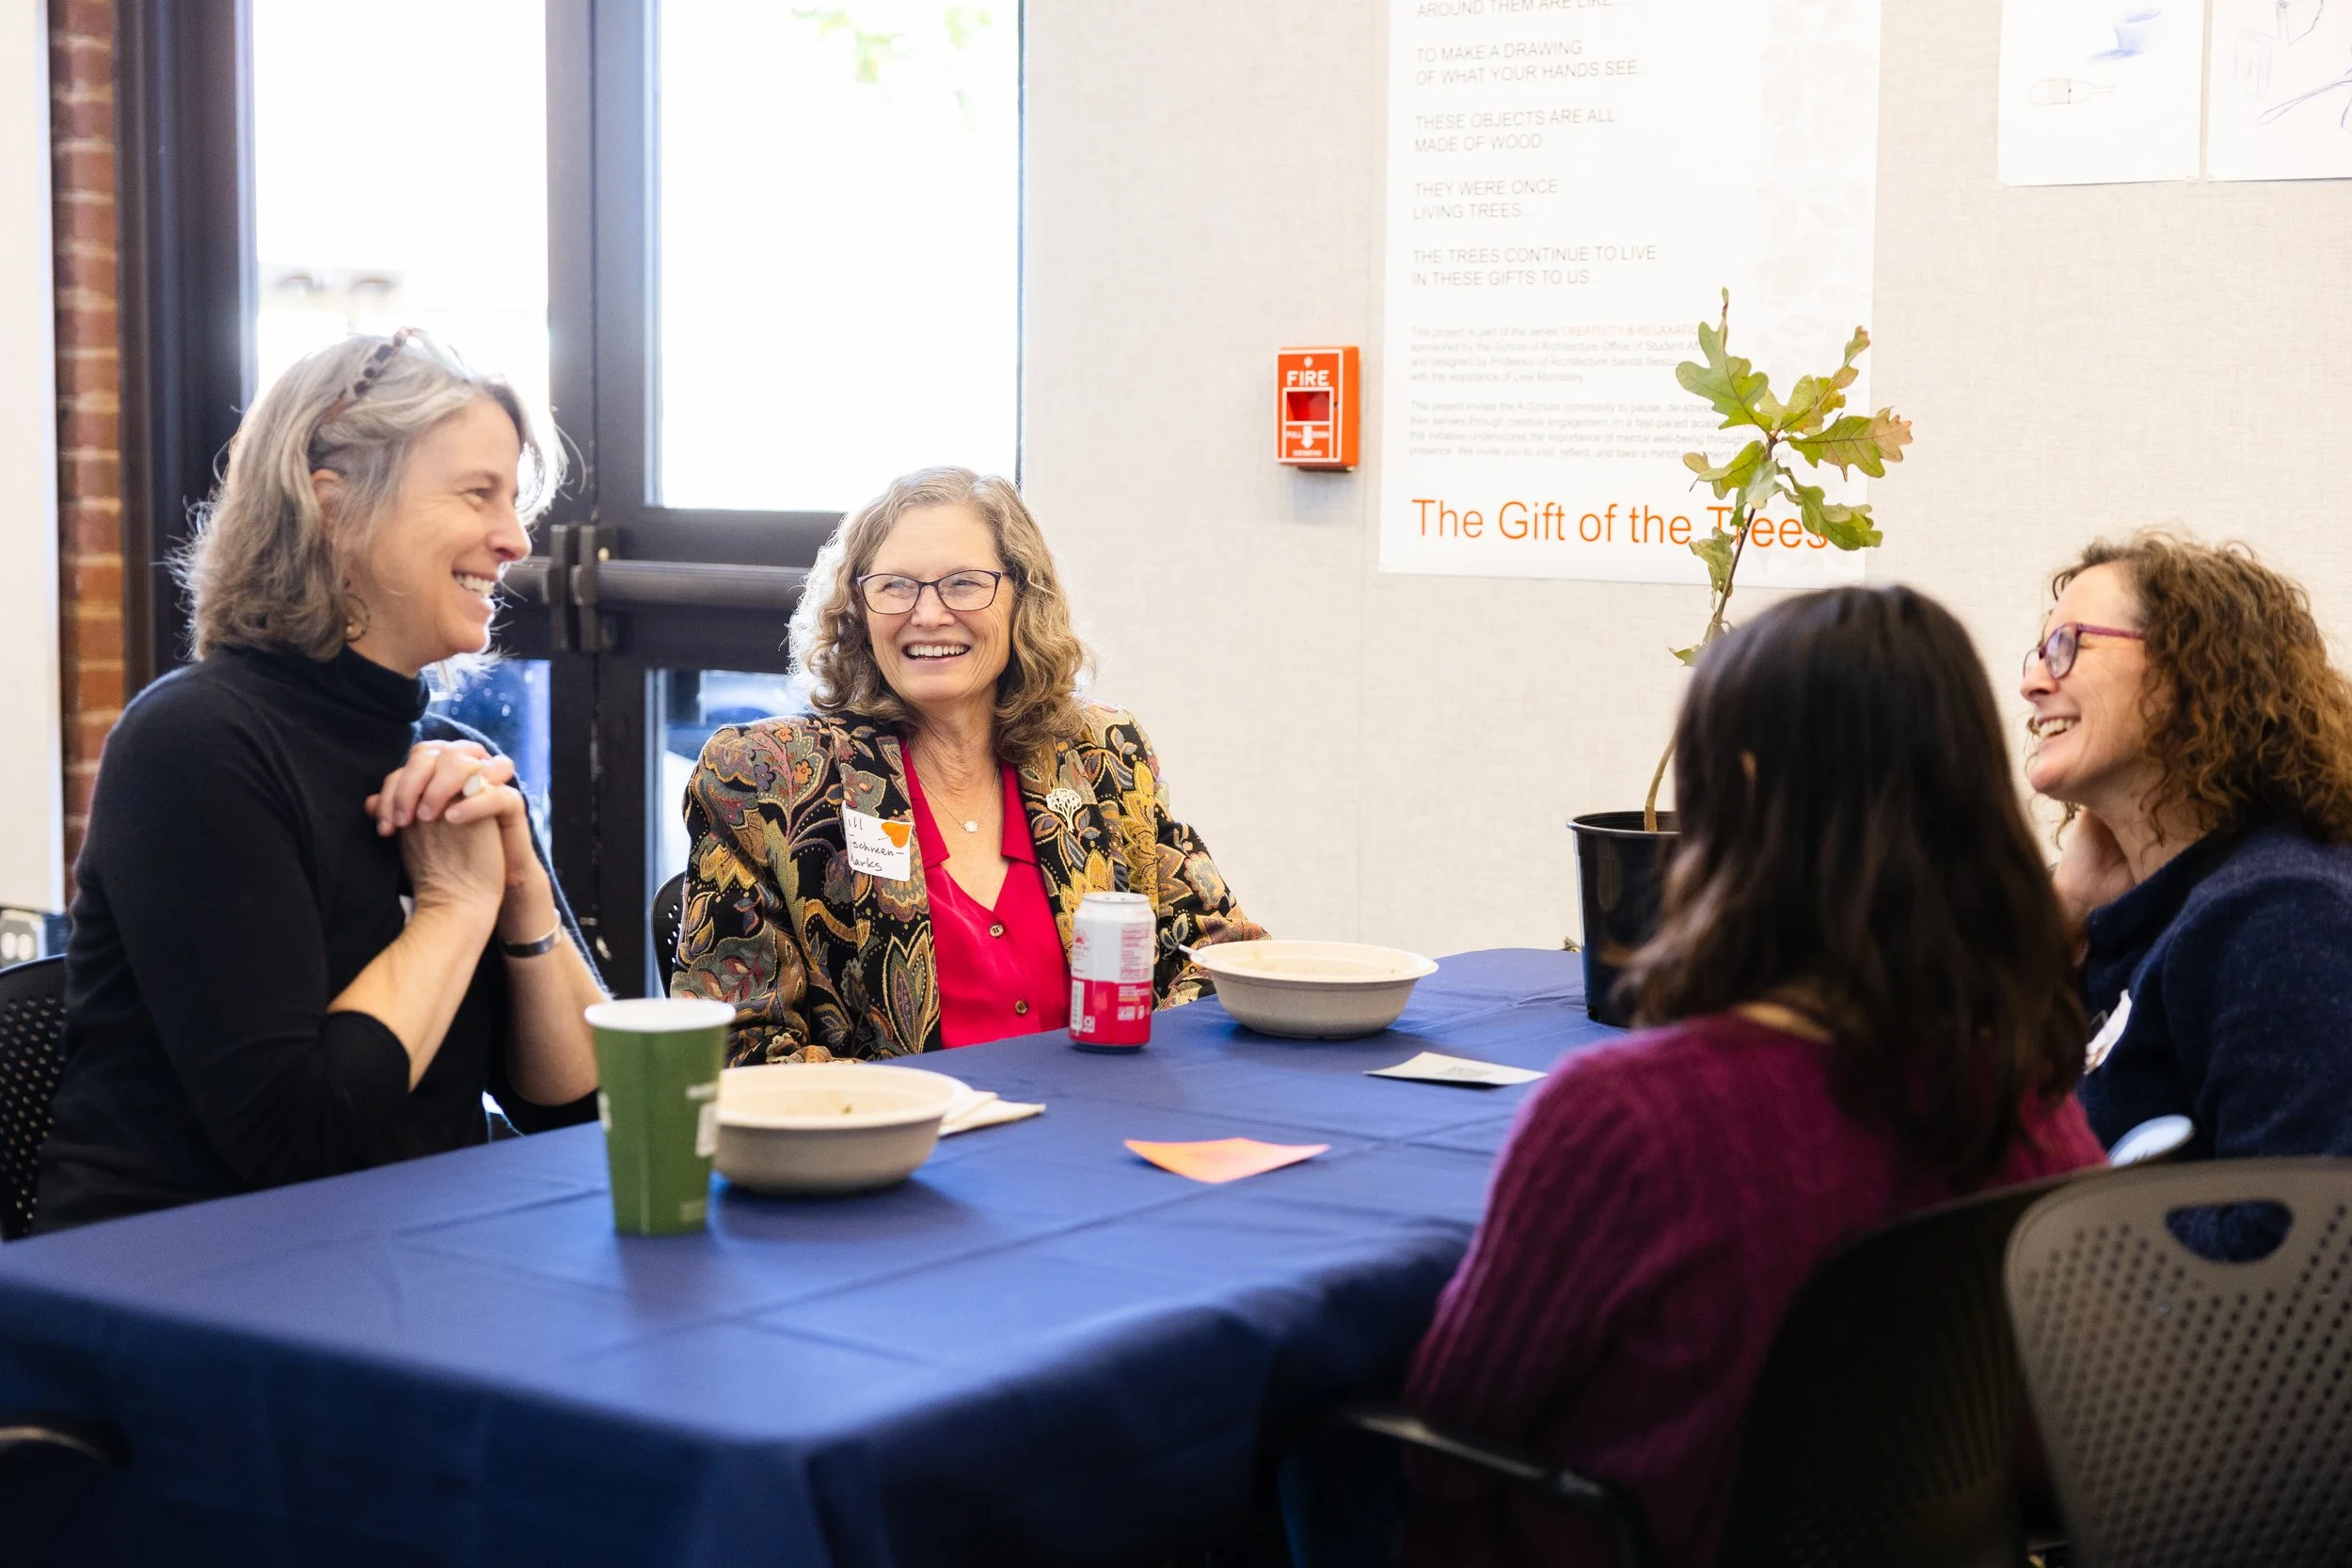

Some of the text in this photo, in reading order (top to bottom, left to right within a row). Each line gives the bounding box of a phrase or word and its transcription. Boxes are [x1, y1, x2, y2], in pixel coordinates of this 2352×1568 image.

[1417, 0, 1485, 18] AROUND
[1491, 0, 1534, 12] THEM
[1538, 0, 1572, 10] ARE
[1417, 40, 1583, 63] TO MAKE A DRAWING
[1415, 70, 1436, 86] OF
[1441, 68, 1486, 84] WHAT
[1490, 65, 1537, 81] YOUR
[1543, 61, 1599, 79] HANDS
[1415, 108, 1616, 130] THESE OBJECTS ARE ALL
[1414, 136, 1459, 153] MADE
[1463, 135, 1486, 150] OF
[1414, 179, 1559, 198] THEY WERE ONCE
[1413, 204, 1464, 220] LIVING
[1413, 245, 1658, 264] THE TREES CONTINUE TO LIVE
[1412, 271, 1427, 286] IN
[1431, 271, 1484, 286] THESE
[1488, 270, 1536, 286] GIFTS
[1540, 269, 1563, 285] TO
[1561, 325, 1625, 337] CREATIVITY
[1636, 324, 1698, 336] RELAXATIO
[1476, 341, 1490, 352] the
[1494, 341, 1527, 352] School
[1542, 341, 1598, 352] Architecture
[1550, 356, 1609, 367] Architecture
[1286, 370, 1329, 387] FIRE
[1411, 499, 1484, 539] The
[1499, 501, 1565, 542] Gift
[1580, 503, 1619, 543] of
[1629, 503, 1692, 545] the
